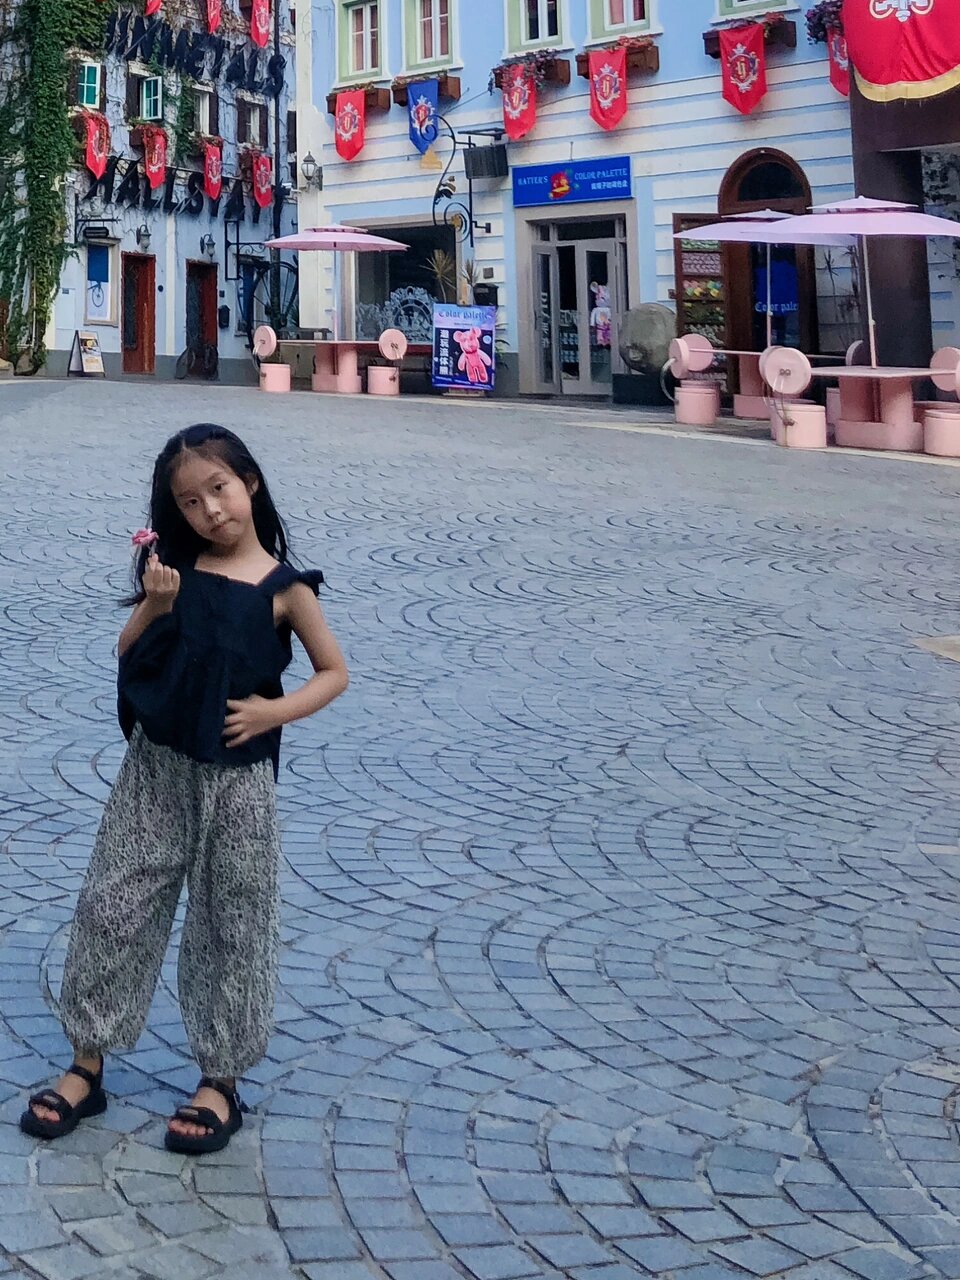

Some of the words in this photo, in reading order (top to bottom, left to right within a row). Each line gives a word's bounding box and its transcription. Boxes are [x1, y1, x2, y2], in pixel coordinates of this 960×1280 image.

[574, 171, 597, 181] COLOR
[597, 168, 628, 179] PALETTE
[755, 301, 779, 313] Coor
